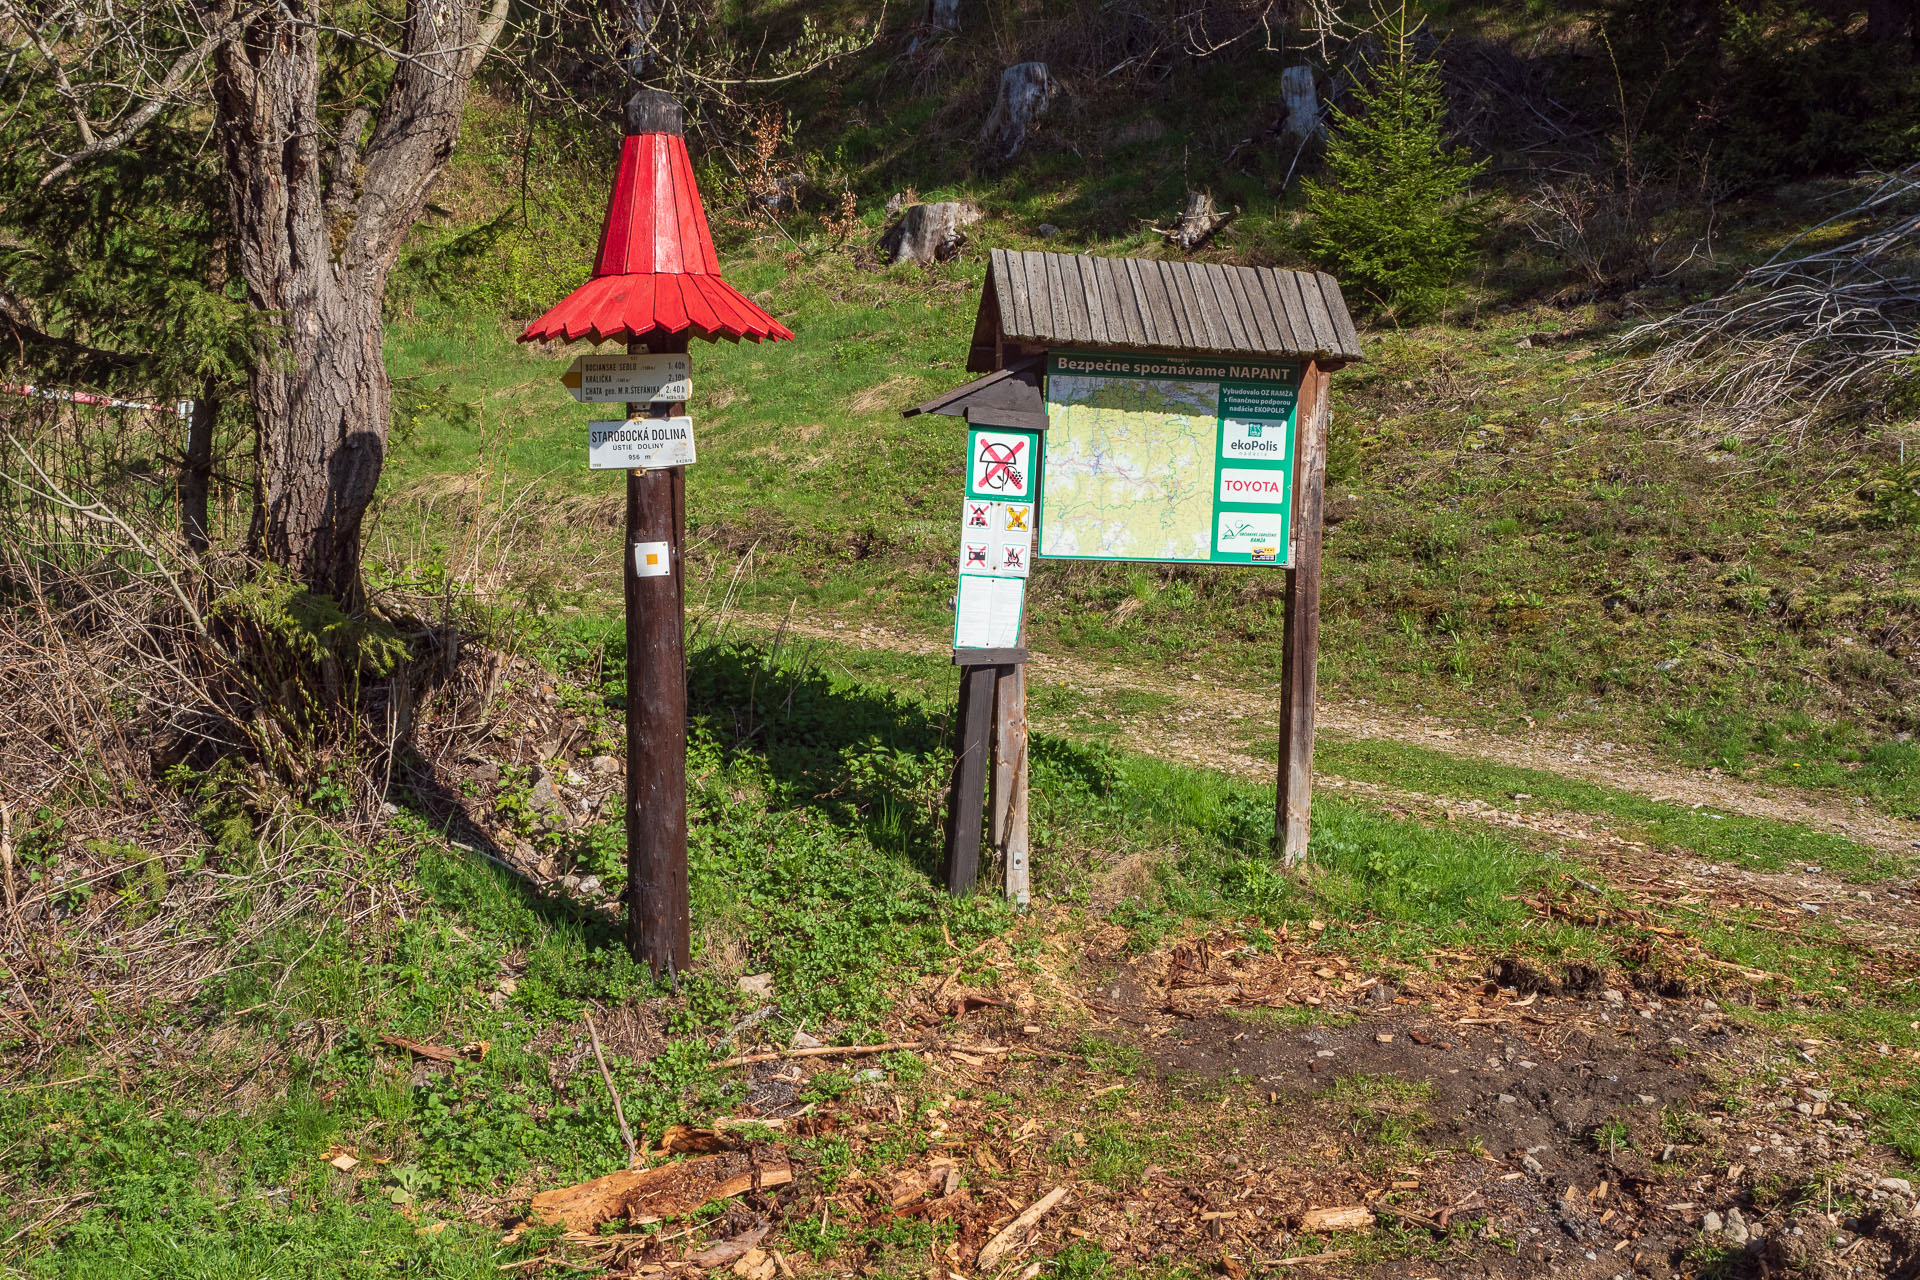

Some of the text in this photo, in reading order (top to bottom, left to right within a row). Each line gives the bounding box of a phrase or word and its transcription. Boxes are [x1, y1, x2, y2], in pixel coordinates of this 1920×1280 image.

[1058, 357, 1290, 380] Bezpečne spoznávame NAPANT
[585, 387, 602, 395] CHATA
[592, 427, 687, 442] STAROBOCKÁ DOLINA
[1231, 440, 1278, 451] ekoPolis
[1225, 480, 1279, 492] TOYOTA
